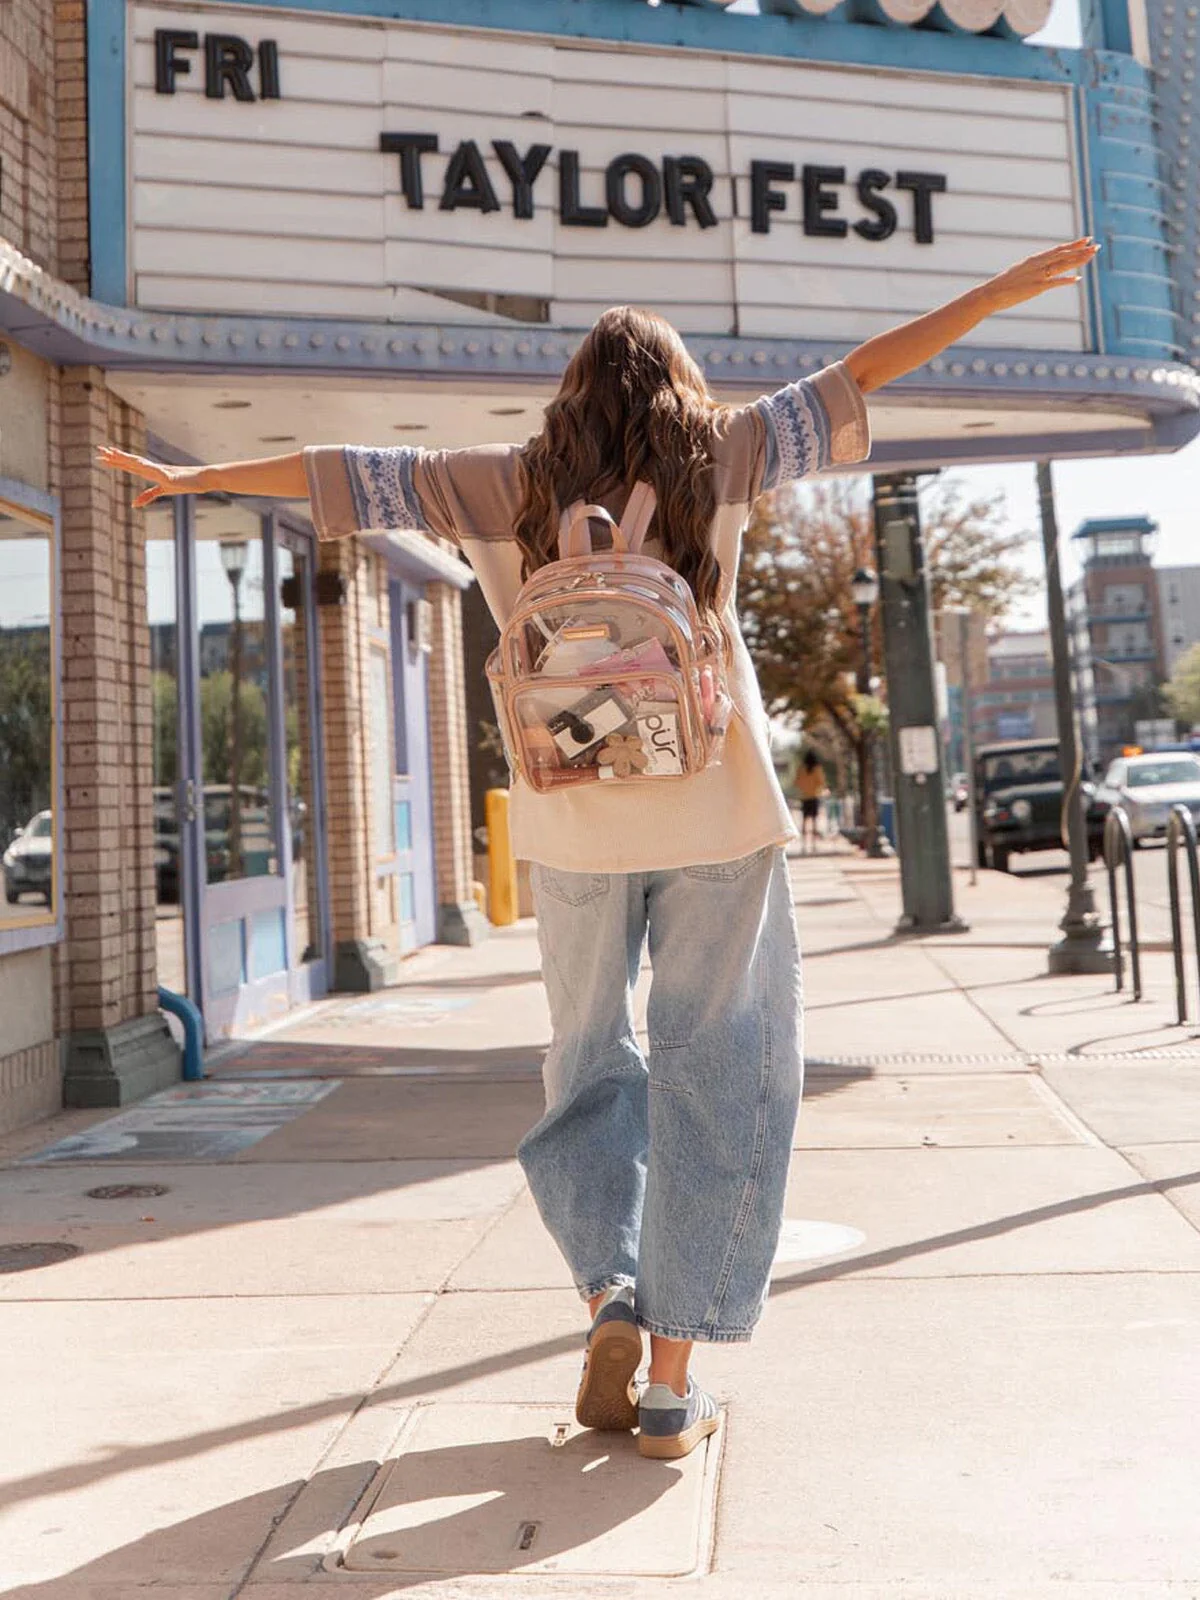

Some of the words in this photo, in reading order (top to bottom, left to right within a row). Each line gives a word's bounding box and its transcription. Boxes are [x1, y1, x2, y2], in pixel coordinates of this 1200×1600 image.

[155, 28, 281, 102] FRI
[380, 132, 718, 230] TAYLOR
[751, 159, 947, 244] FEST
